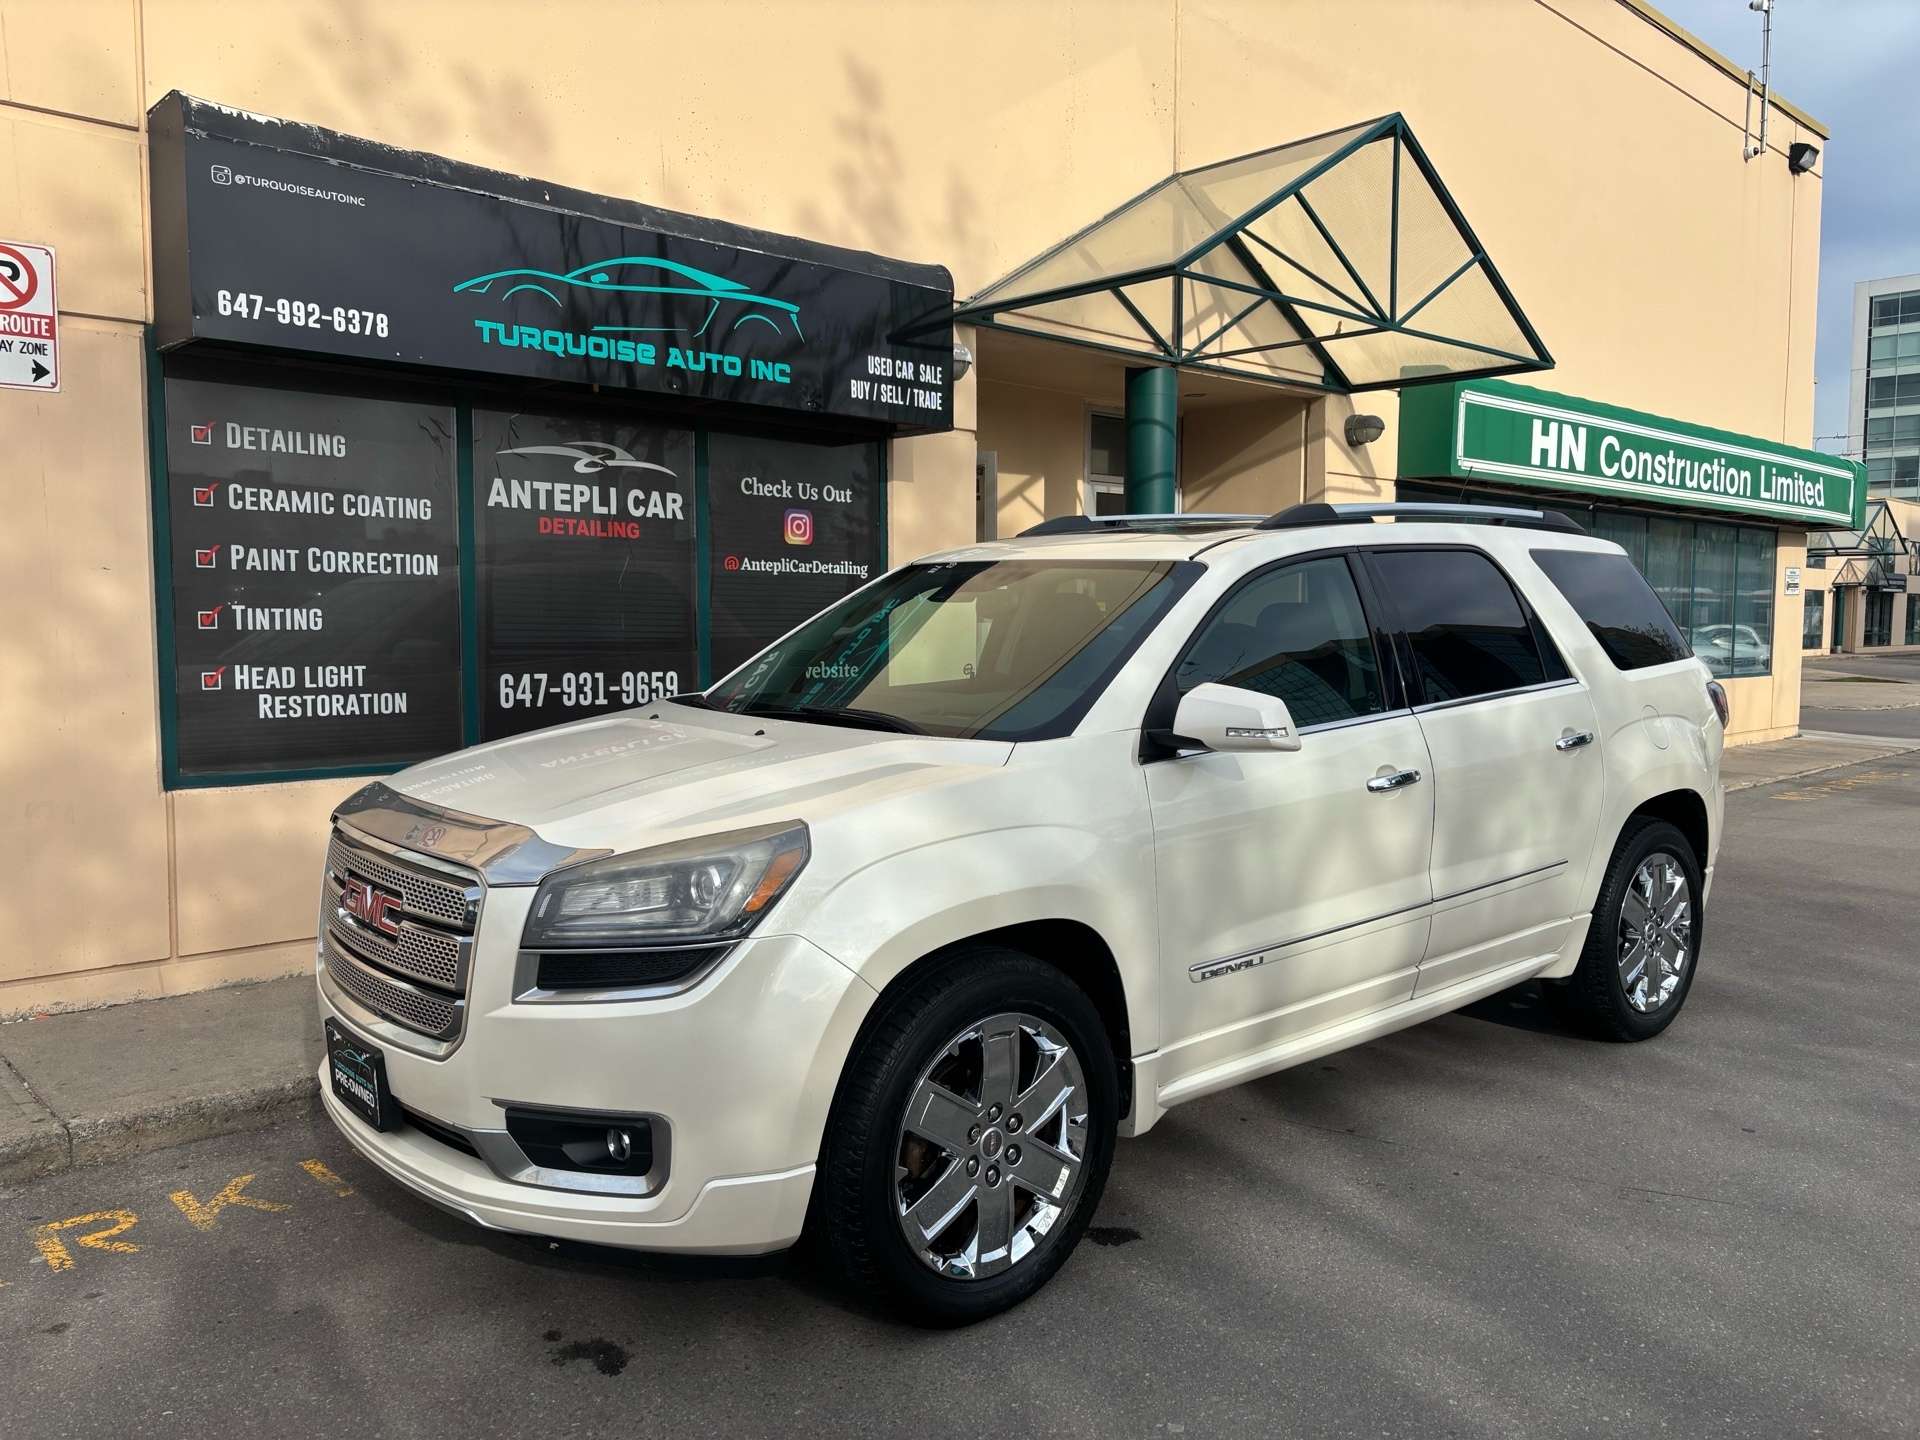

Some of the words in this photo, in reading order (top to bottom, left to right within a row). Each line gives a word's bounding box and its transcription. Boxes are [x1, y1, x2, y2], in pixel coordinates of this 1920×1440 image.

[235, 173, 366, 206] @TURQUOISEAUTOINC
[0, 313, 50, 337] ROUTE
[217, 289, 389, 338] 647-992-6378
[18, 340, 48, 357] ZONE
[666, 346, 743, 377] AUTO
[750, 359, 792, 384] INC
[868, 355, 893, 377] USED
[895, 360, 915, 381] CAR
[919, 363, 943, 385] SALE
[850, 379, 871, 400] BUY
[880, 384, 904, 405] SELL
[913, 388, 943, 411] TRADE
[226, 422, 347, 458] DETAILING
[1530, 418, 1588, 473] HN
[1599, 434, 1752, 499] Construction
[1759, 464, 1825, 508] Limited
[228, 483, 335, 515] CERAMIC
[342, 493, 432, 521] COATING
[487, 477, 617, 516] ANTEPLI
[626, 488, 685, 521] CAR
[740, 476, 793, 500] Check
[797, 482, 819, 502] Us
[822, 484, 853, 504] Out
[538, 515, 641, 540] DETAILING
[230, 544, 300, 572] PAINT
[307, 547, 439, 576] CORRECTION
[231, 604, 323, 631] TINTING
[234, 664, 296, 690] HEAD
[304, 665, 367, 688] LIGHT
[499, 670, 679, 709] 647-931-9659
[258, 692, 407, 719] RESTORATION
[341, 877, 402, 937] GMC
[1200, 955, 1264, 981] DENALI
[335, 1068, 376, 1109] PRE-OWNED
